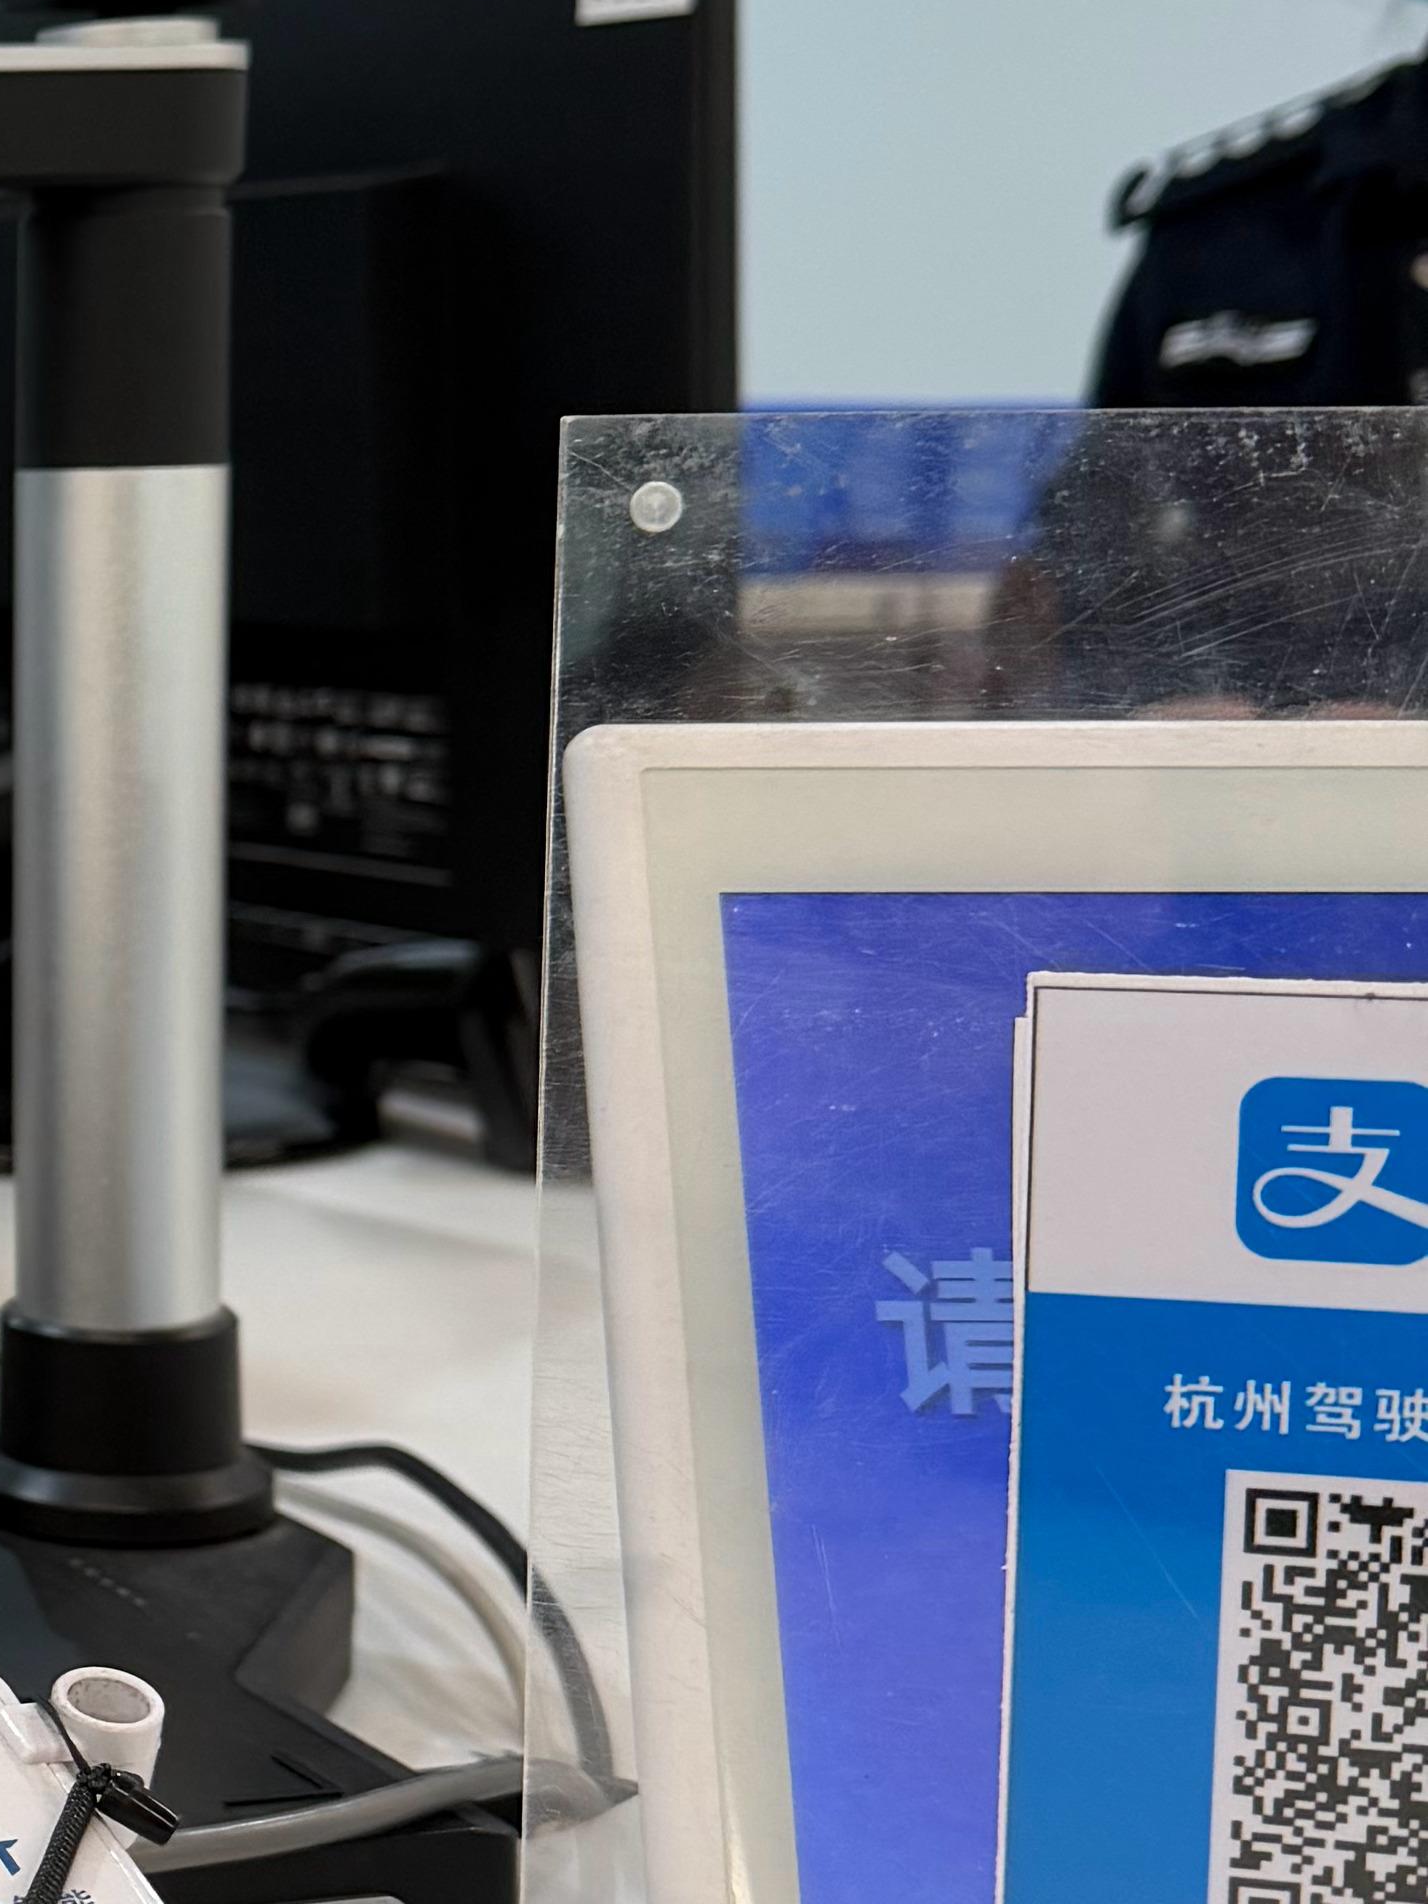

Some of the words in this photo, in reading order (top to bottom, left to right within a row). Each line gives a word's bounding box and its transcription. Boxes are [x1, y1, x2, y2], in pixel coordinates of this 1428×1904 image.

[874, 1246, 1014, 1415] 请
[1163, 1372, 1428, 1443] 杭州驾驶
